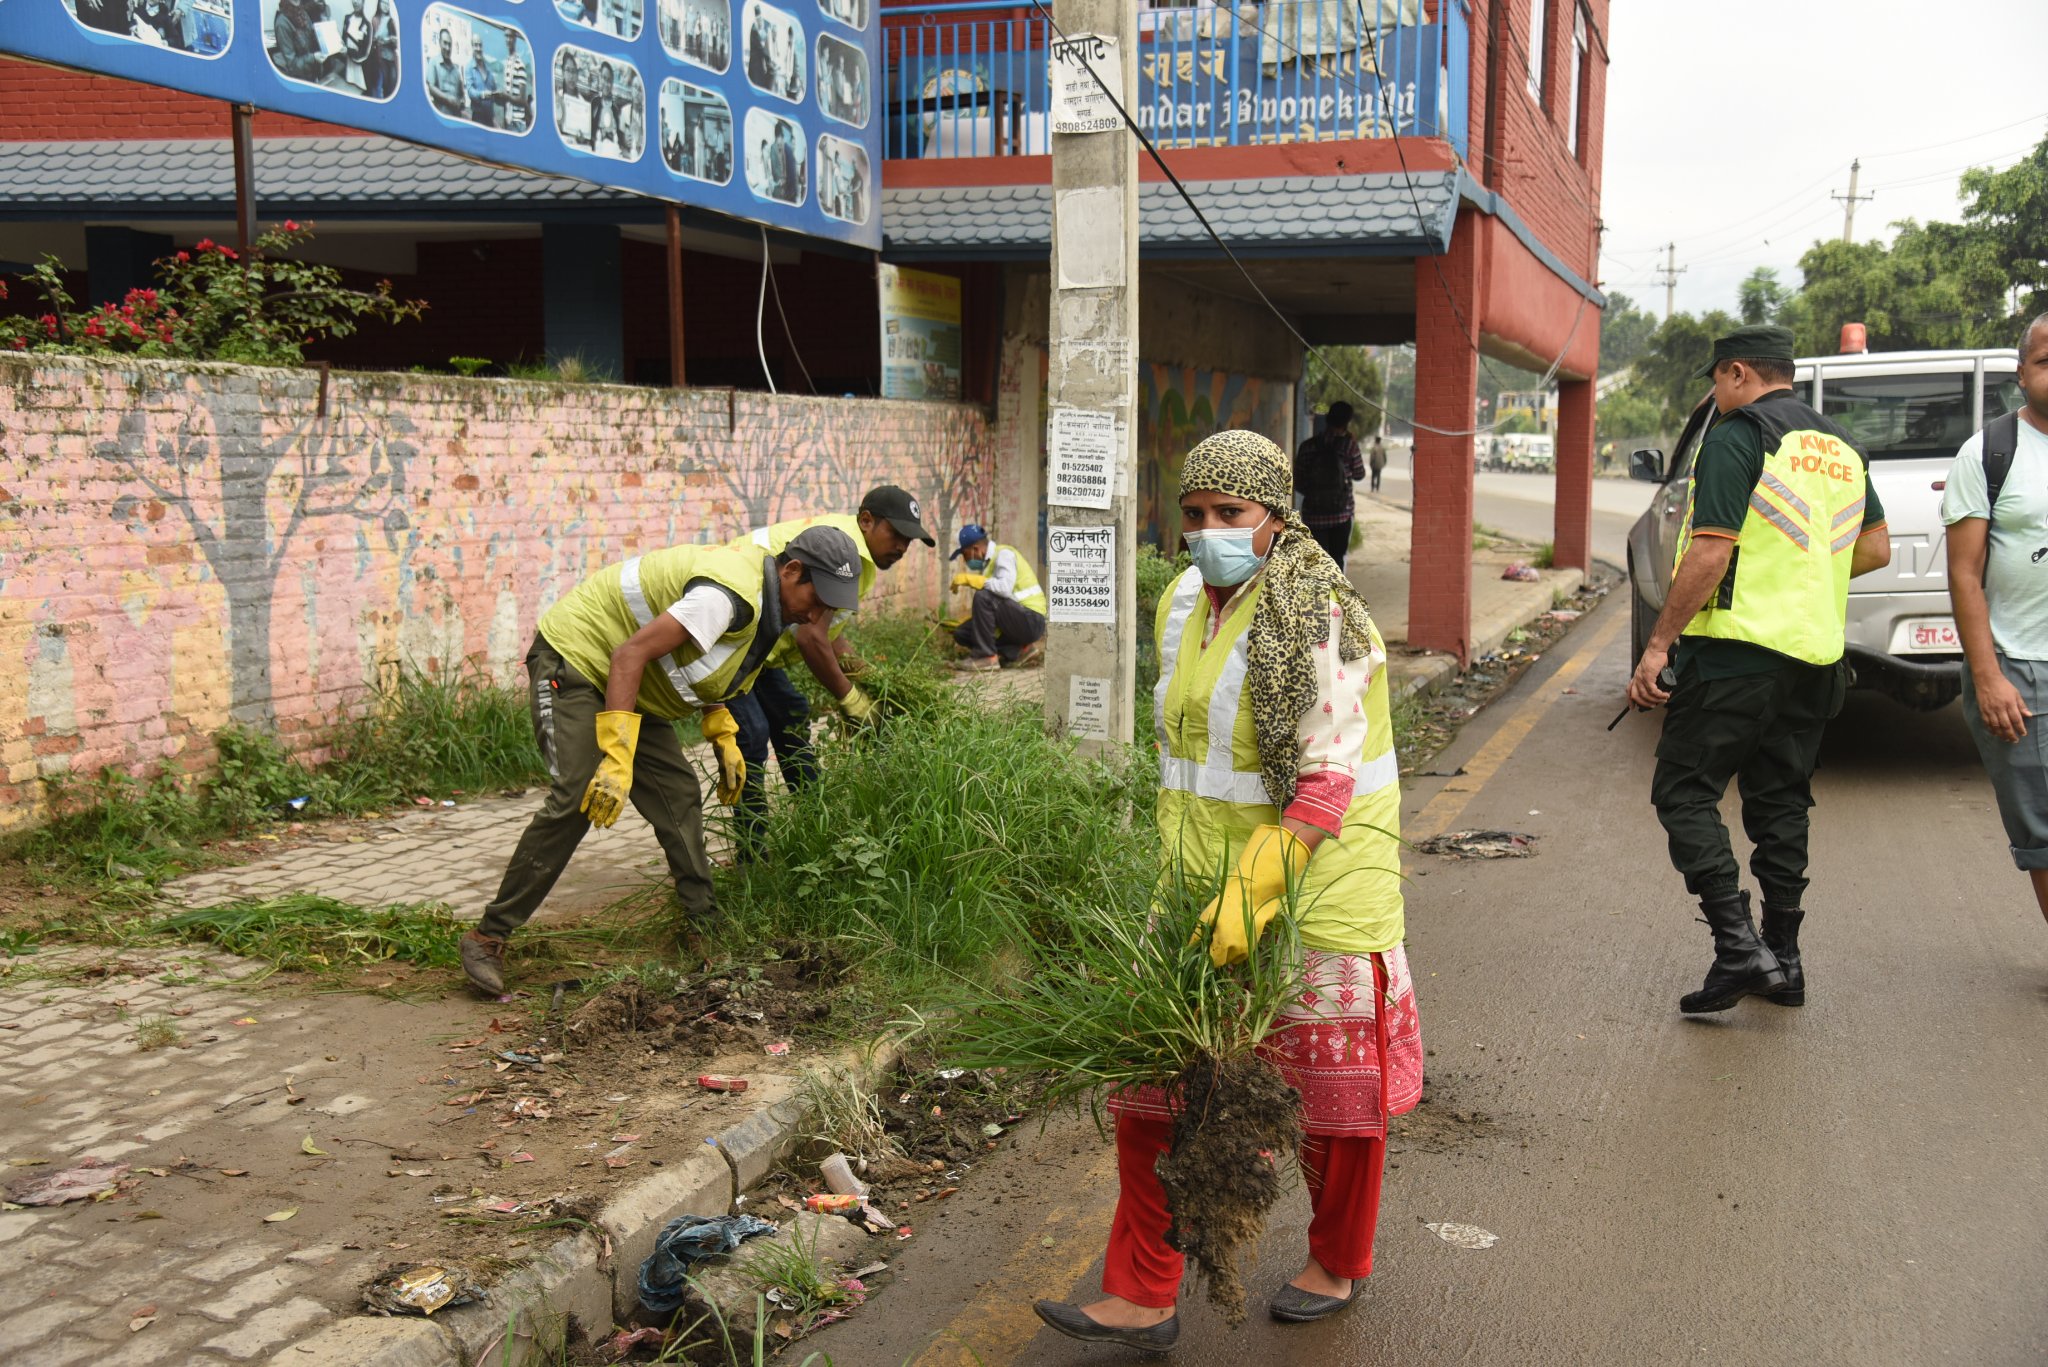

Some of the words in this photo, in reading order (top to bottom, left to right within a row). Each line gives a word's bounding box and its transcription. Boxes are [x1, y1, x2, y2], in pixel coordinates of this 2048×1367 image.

[1056, 117, 1118, 133] 9808524809
[1062, 462, 1103, 473] 01-5225402
[1057, 473, 1107, 485] 9823658864
[1057, 486, 1105, 498] 9862907437
[1066, 530, 1111, 544] कर्मचारी
[1052, 585, 1110, 595] 9843304389
[1051, 597, 1110, 608] 9813558490
[538, 679, 553, 718] NIKE
